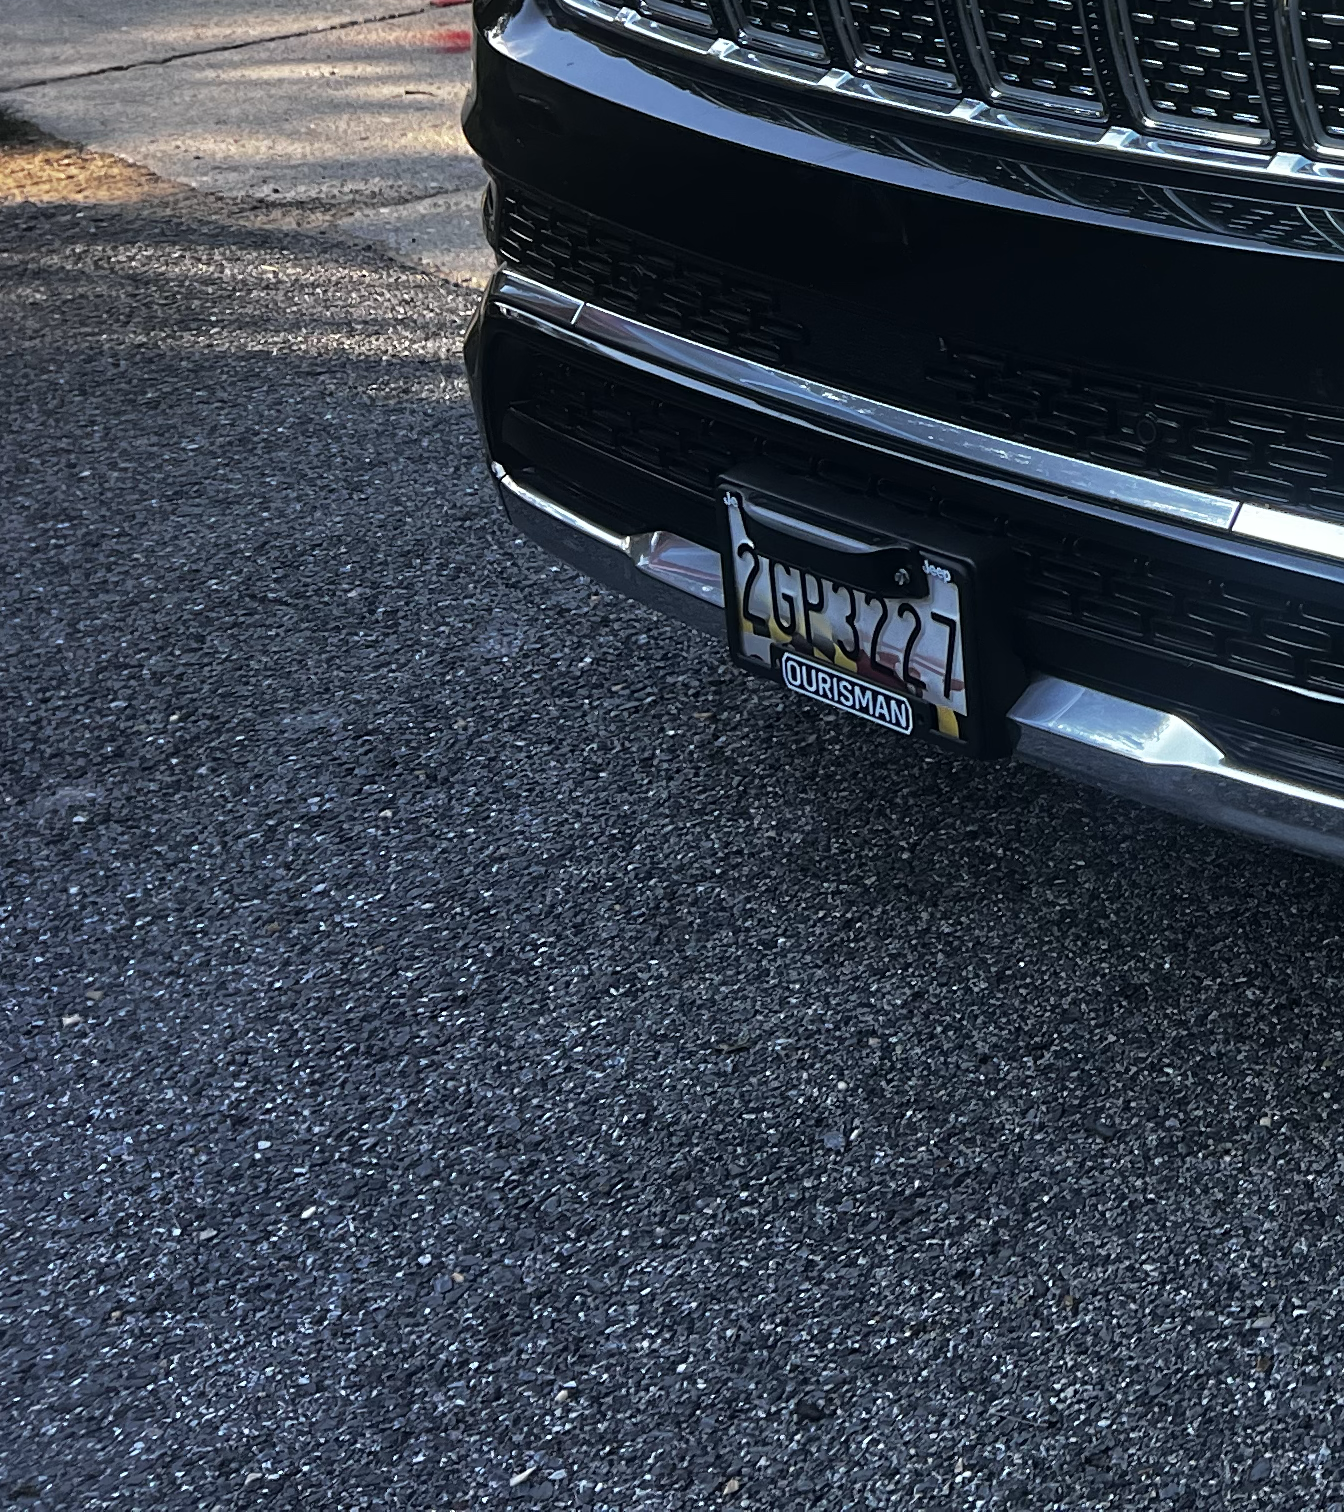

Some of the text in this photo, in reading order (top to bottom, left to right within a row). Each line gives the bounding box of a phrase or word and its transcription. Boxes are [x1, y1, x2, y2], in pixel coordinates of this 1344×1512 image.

[921, 559, 952, 584] Jeep
[737, 542, 958, 700] 2GP3227
[786, 660, 907, 729] OURISMAN
